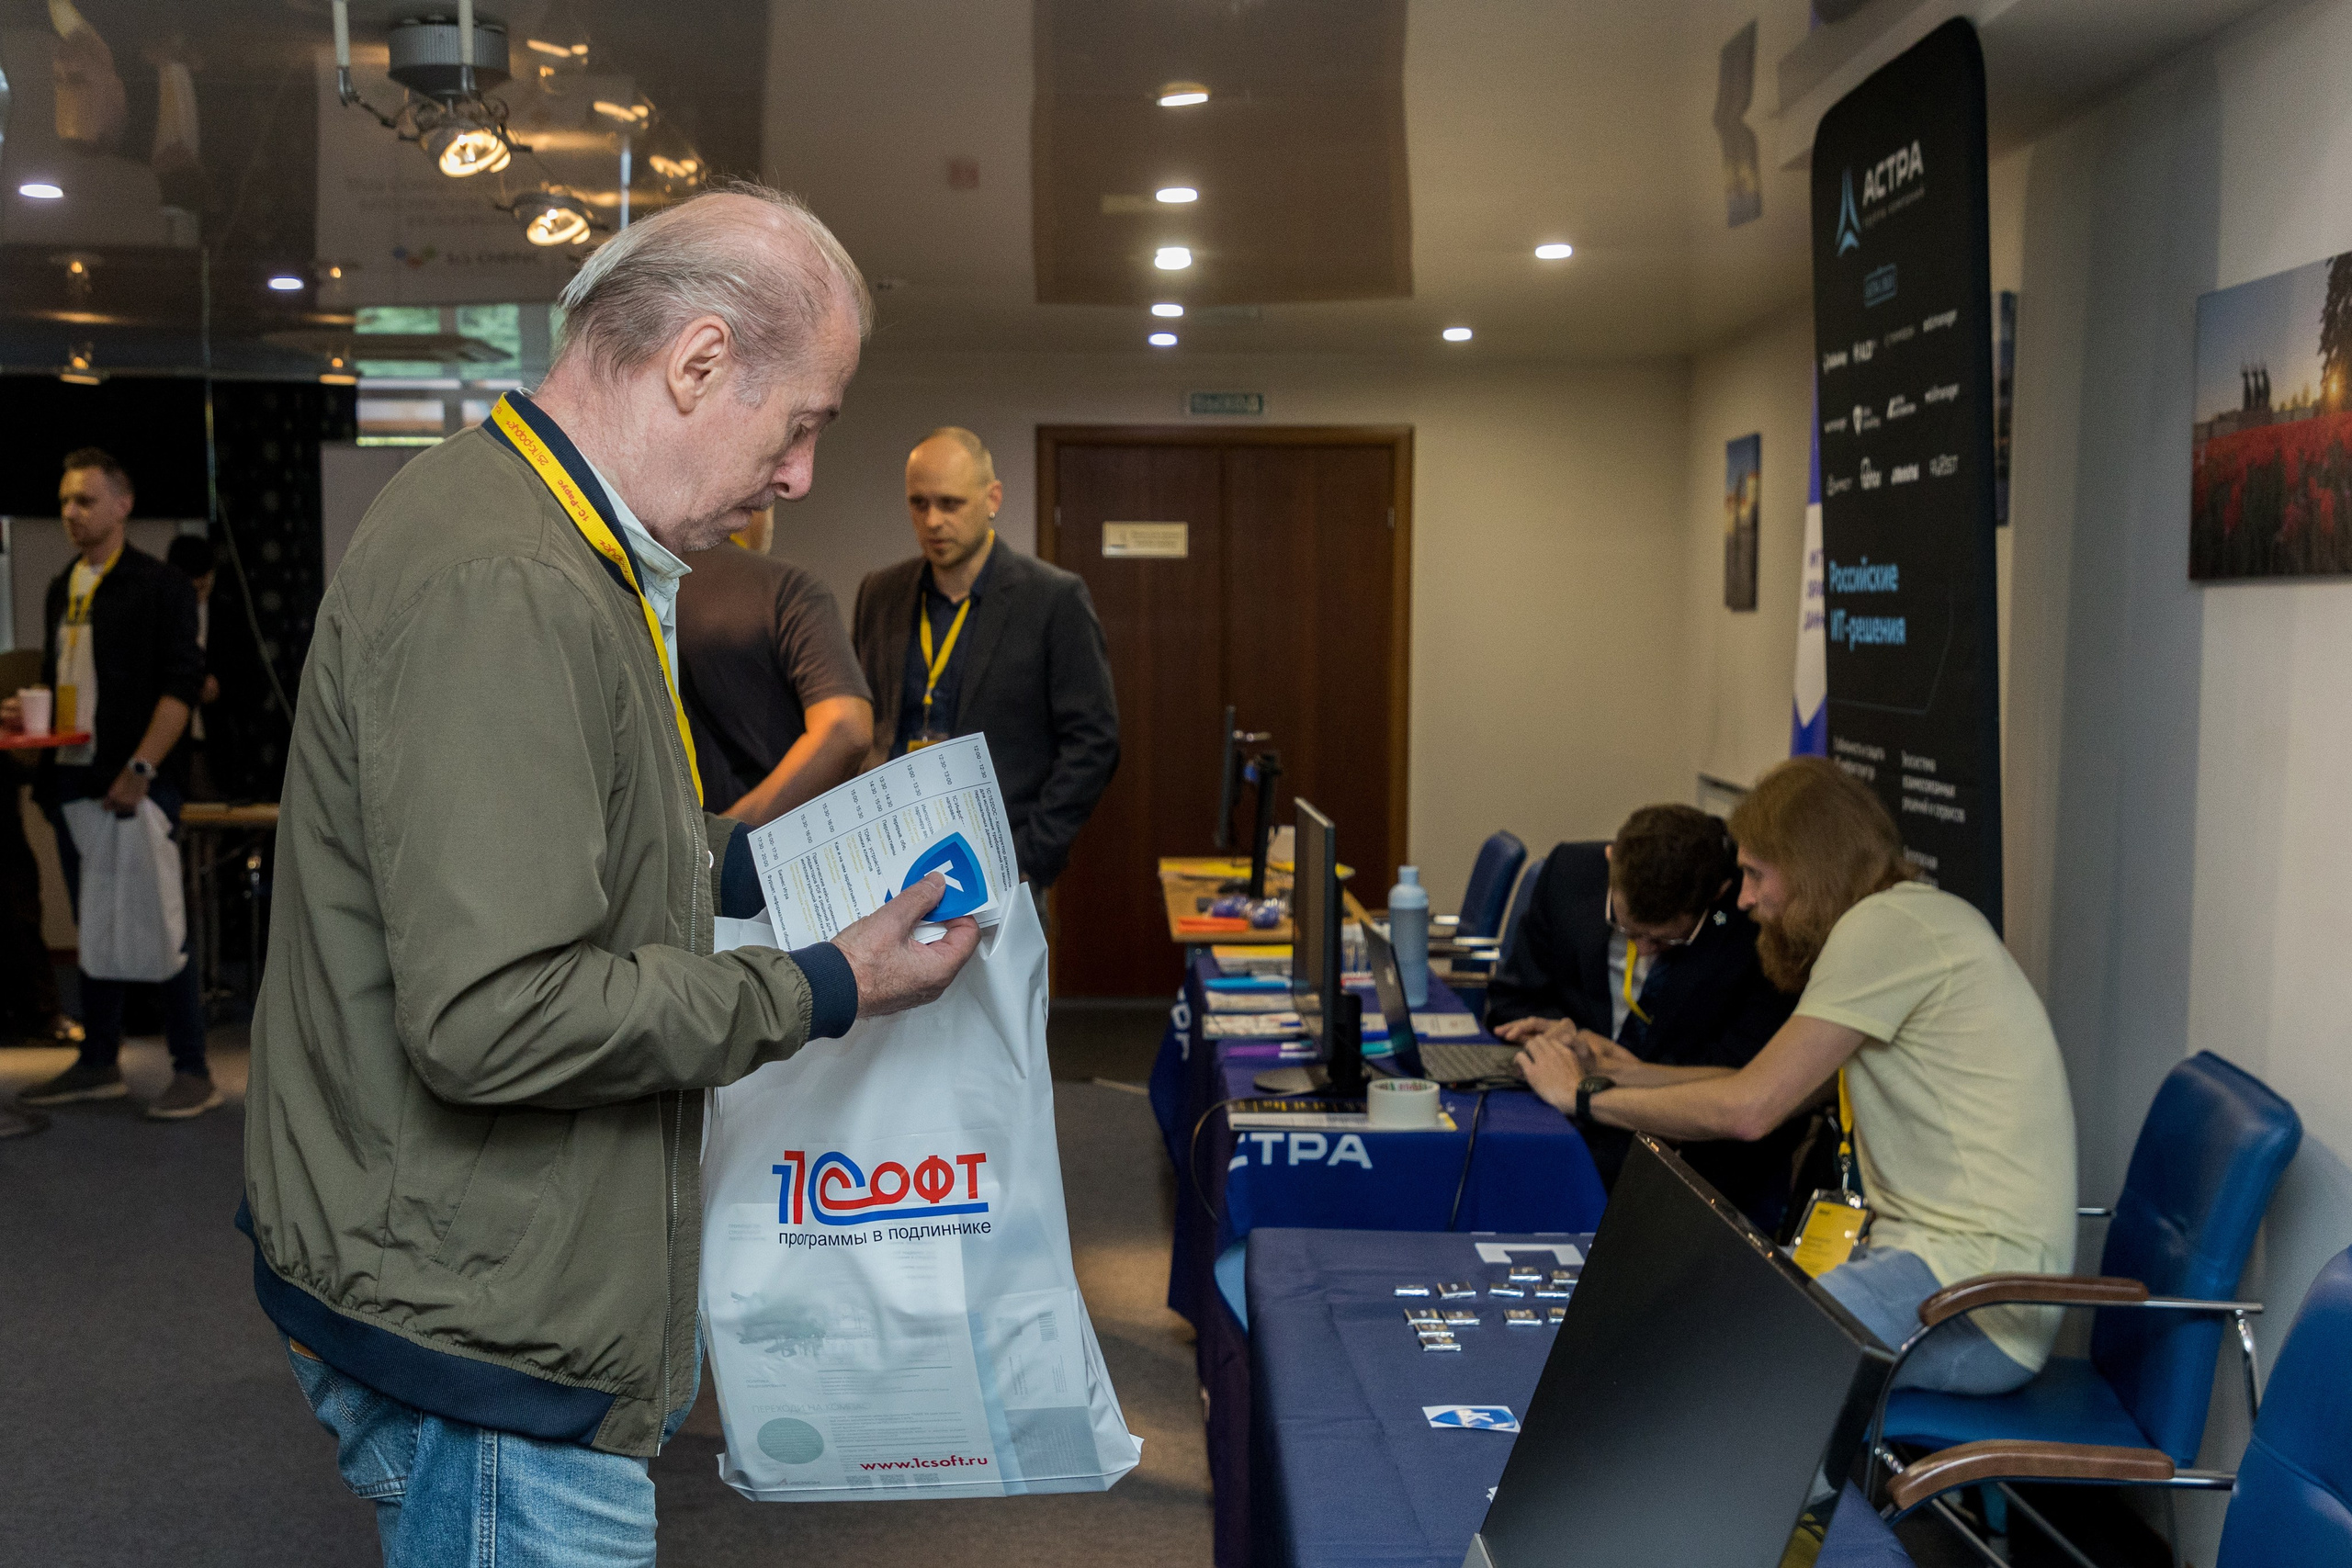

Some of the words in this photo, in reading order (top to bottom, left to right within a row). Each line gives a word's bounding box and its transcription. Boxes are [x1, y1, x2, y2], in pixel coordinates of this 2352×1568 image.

[1862, 140, 1925, 208] АСТРА
[555, 477, 591, 523] 1С-Рарус
[1829, 557, 1899, 593] Российские
[1830, 609, 1906, 651] ИТ-решения
[943, 770, 953, 785] 13:00
[971, 744, 982, 760] 12:00
[978, 762, 988, 779] 12:30
[867, 779, 877, 795] 14:30
[874, 797, 883, 813] 15:00
[877, 774, 888, 790] 13:30
[884, 792, 893, 808] 14:30
[906, 762, 916, 779] 13:00
[911, 781, 922, 796] 13:30
[978, 787, 987, 798] для
[826, 818, 835, 833] 16:00
[854, 804, 865, 819] 15:30
[972, 788, 989, 828] персональных
[983, 827, 994, 849] данных
[981, 797, 995, 830] исполнения
[755, 835, 764, 850] 17:30
[760, 852, 770, 868] 20:00
[770, 846, 779, 861] 17:30
[804, 829, 813, 844] 16:00
[856, 830, 865, 848] тонких
[862, 848, 874, 873] клиентов
[989, 830, 1004, 863] требований
[993, 819, 1007, 855] Конструктор
[1001, 854, 1013, 888] документов
[832, 840, 841, 851] Как
[842, 873, 858, 908] зарабатывать
[866, 845, 882, 875] устройства
[775, 868, 786, 887] Бизнес
[780, 886, 790, 900] Игра
[797, 857, 817, 903] интеллектуальной
[811, 902, 826, 930] обработки
[804, 854, 819, 885] редакторов
[813, 884, 821, 895] PDF
[817, 898, 830, 922] решений
[824, 921, 832, 932] для
[810, 852, 826, 887] Практические
[820, 886, 831, 903] кейсы
[764, 874, 777, 896] Фуршет,
[771, 894, 787, 931] неформальное
[779, 1230, 867, 1249] программы
[873, 1230, 883, 1243] в
[888, 1221, 991, 1241] подлиннике
[860, 1455, 989, 1472] www.1csoft.ru
